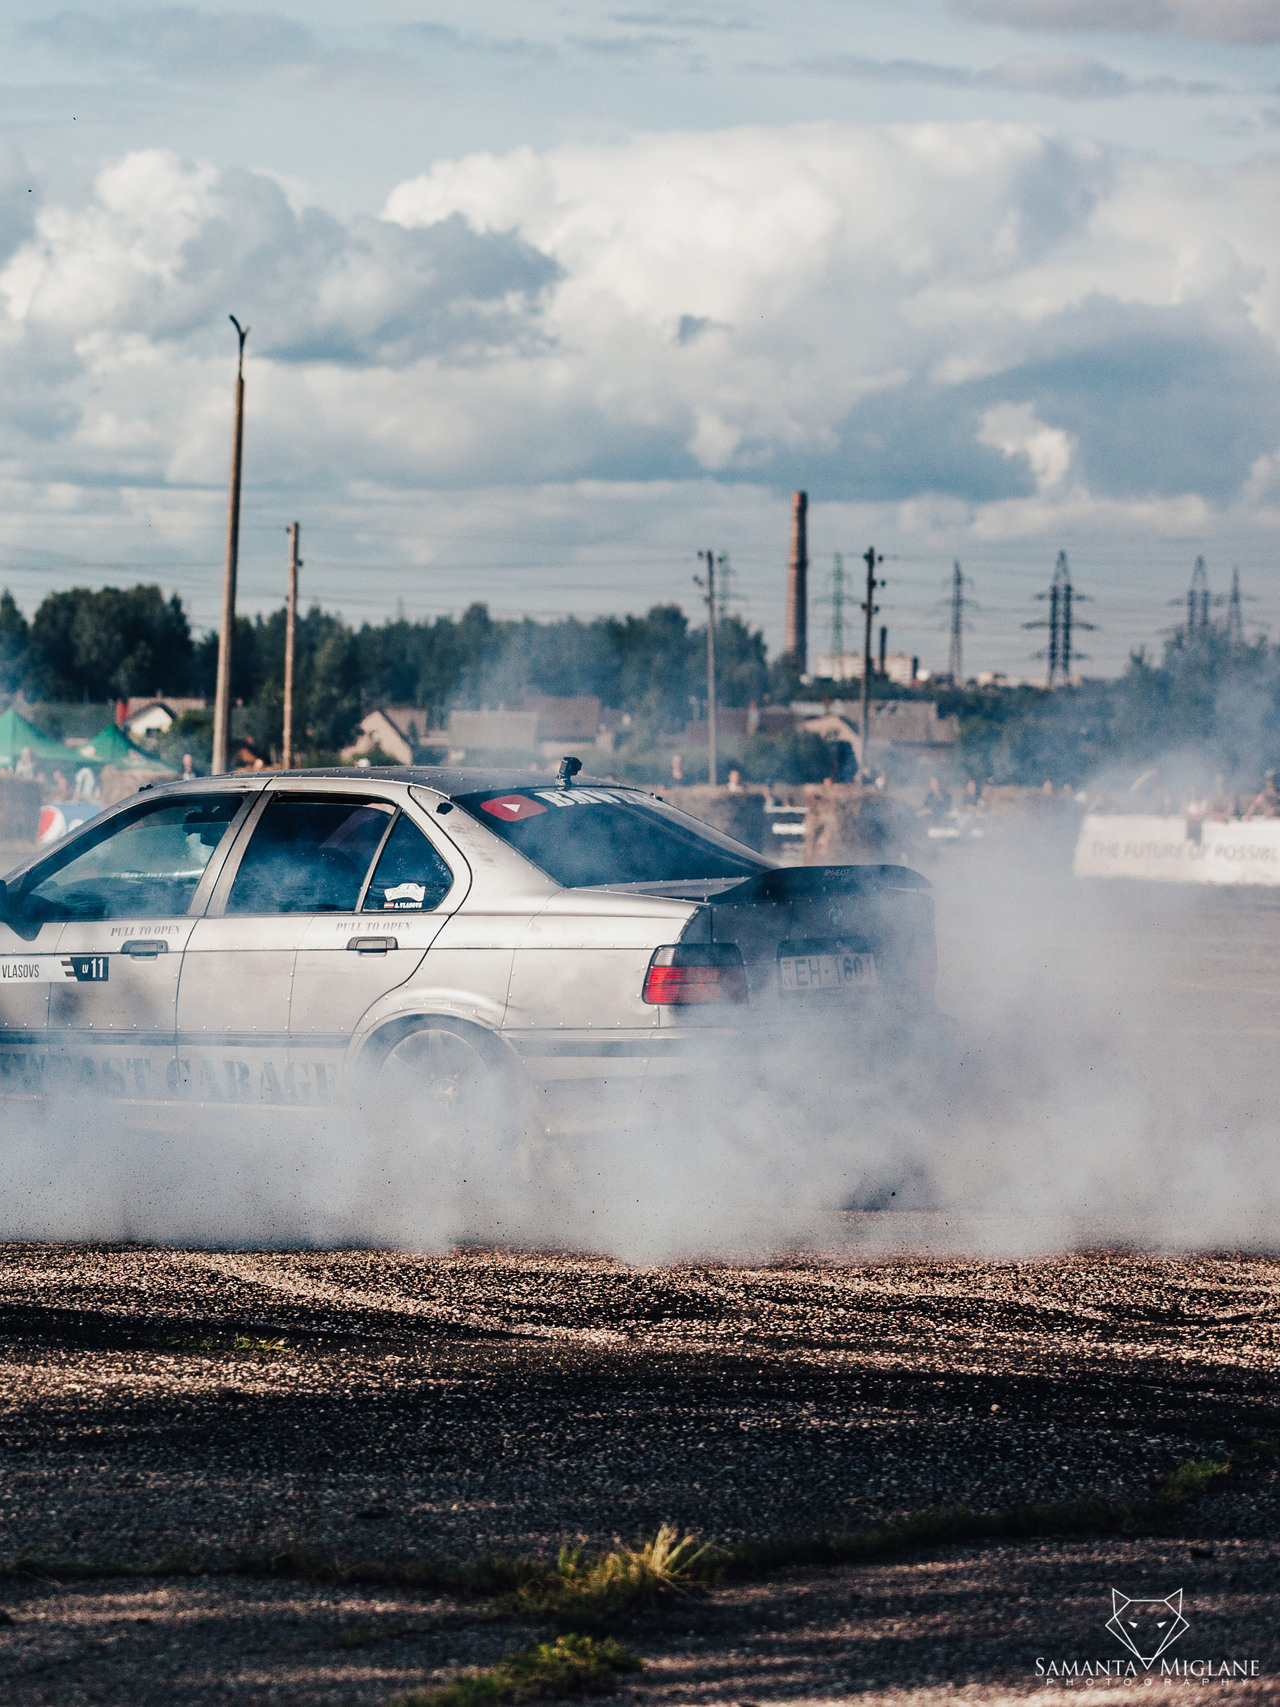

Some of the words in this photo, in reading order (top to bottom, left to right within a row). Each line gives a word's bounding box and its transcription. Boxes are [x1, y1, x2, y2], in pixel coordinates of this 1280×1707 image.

[1123, 840, 1184, 860] FUTURE
[1187, 841, 1210, 860] OF
[110, 926, 136, 937] PULL
[139, 926, 151, 936] TO
[152, 925, 182, 936] OPEN
[336, 922, 362, 932] PULL
[366, 922, 380, 931] TO
[382, 922, 413, 932] OPEN
[2, 964, 40, 978] VLASOVS
[81, 964, 90, 974] LV
[90, 958, 104, 978] 11
